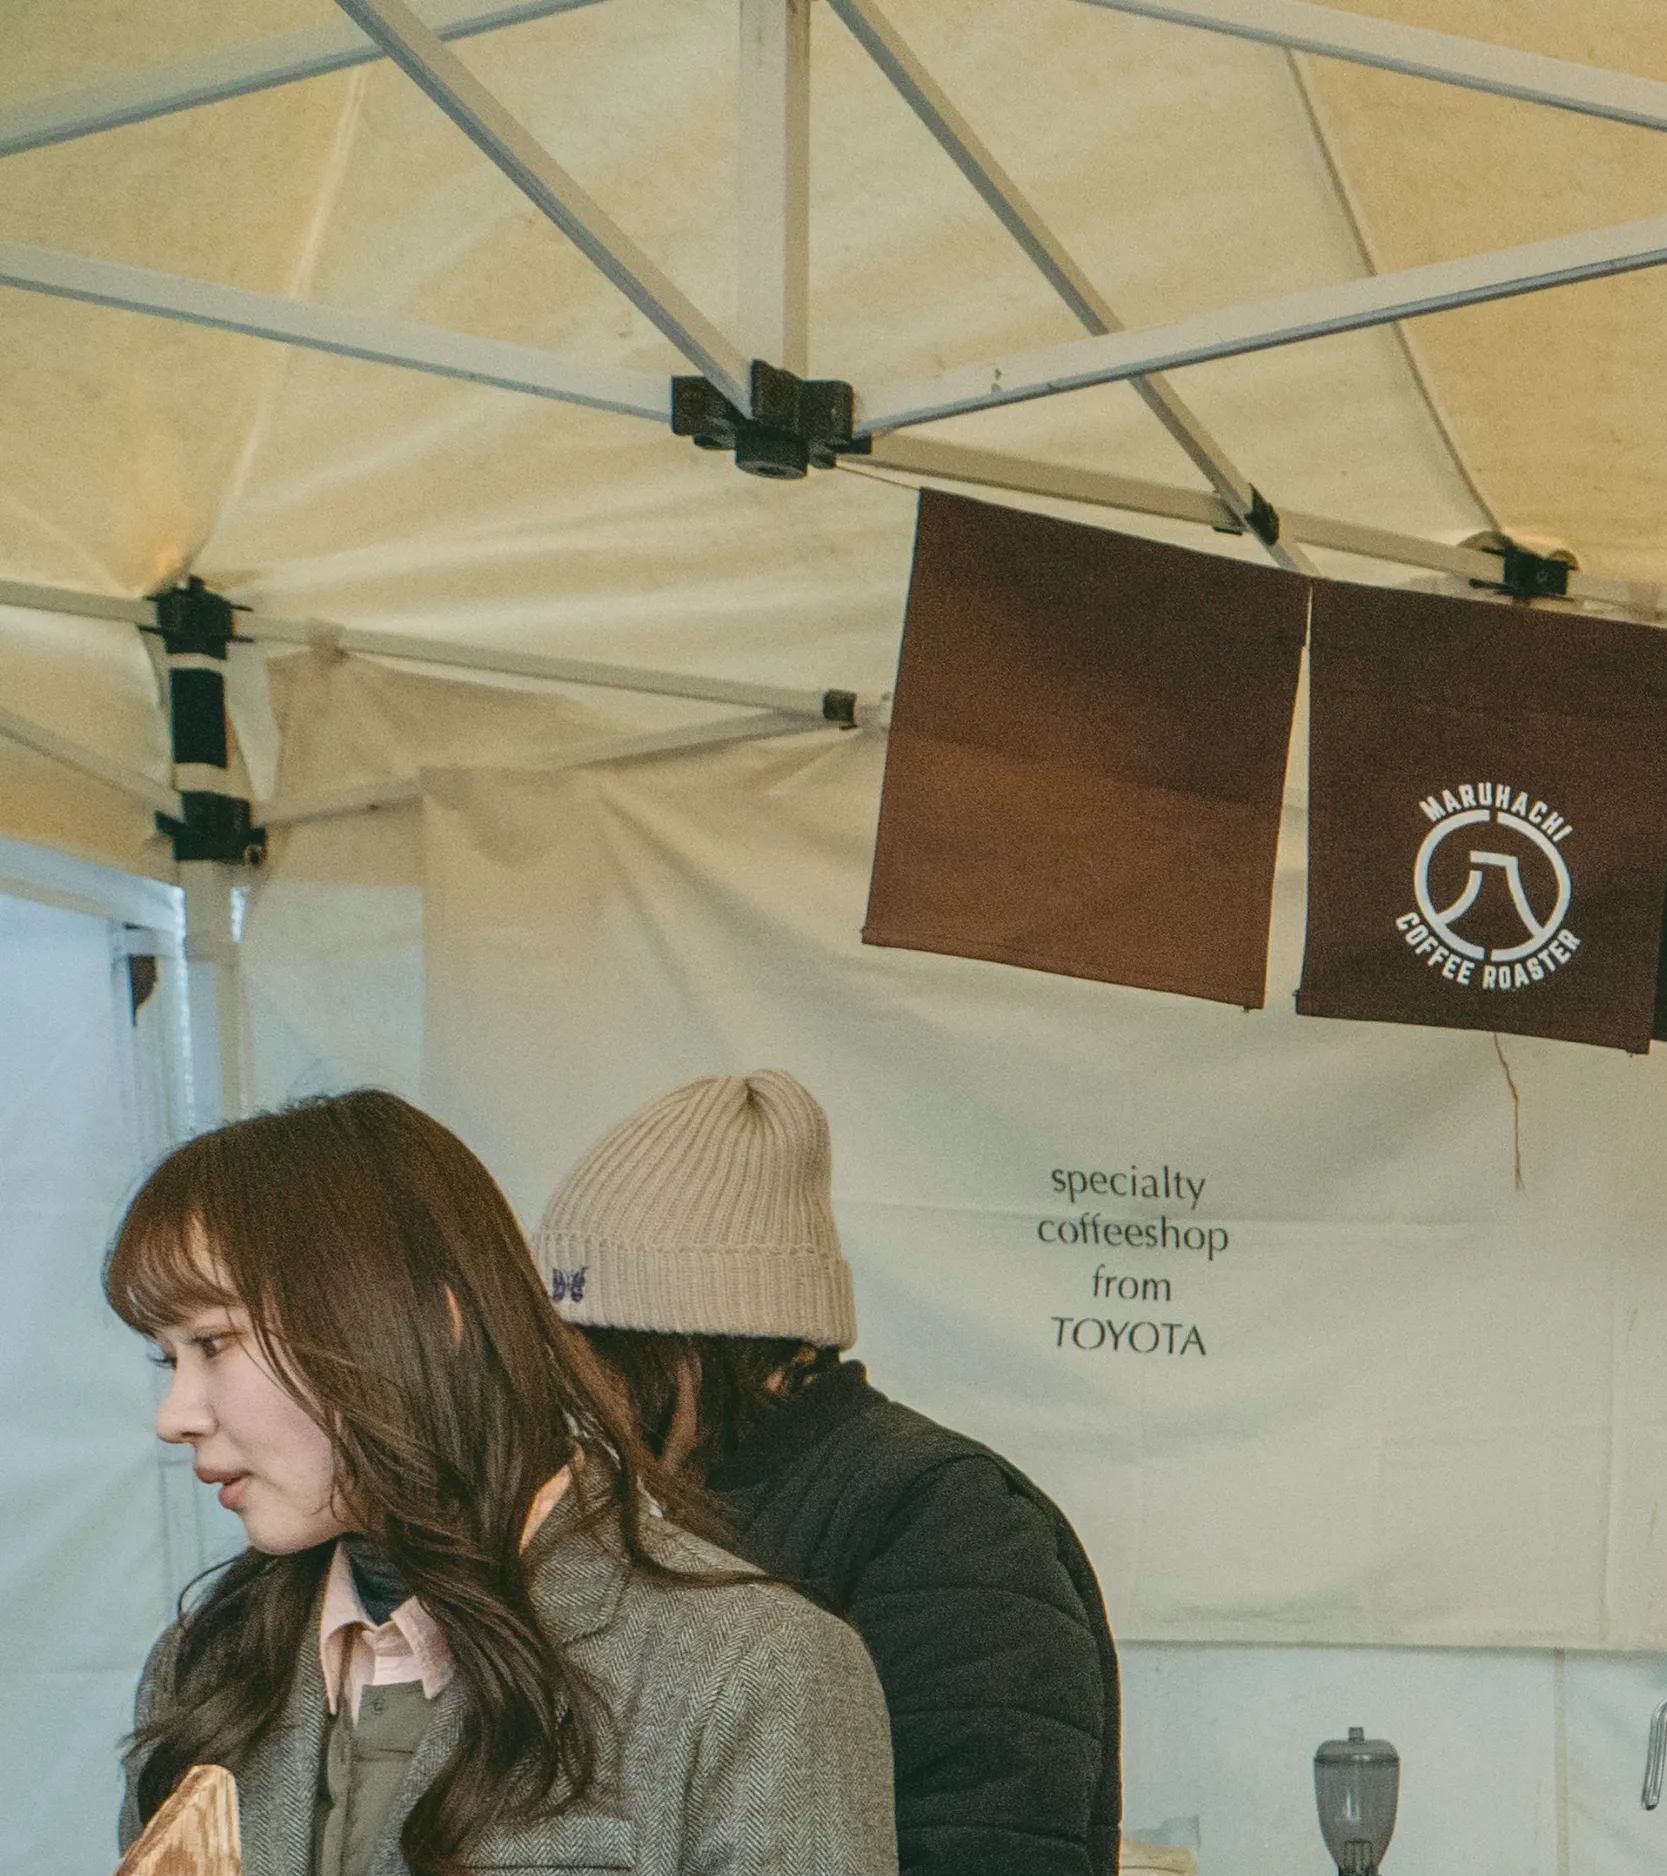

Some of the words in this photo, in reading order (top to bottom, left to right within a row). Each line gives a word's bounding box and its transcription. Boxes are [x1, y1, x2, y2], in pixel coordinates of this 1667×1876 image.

[1418, 781, 1574, 842] MARUHACHI
[1395, 911, 1475, 989] COFFEE
[1483, 926, 1582, 991] ROASTER
[1051, 1165, 1206, 1209] specialty
[1037, 1215, 1230, 1260] coffeeshop
[1091, 1264, 1172, 1303] from
[1050, 1316, 1208, 1359] TOYOTA
